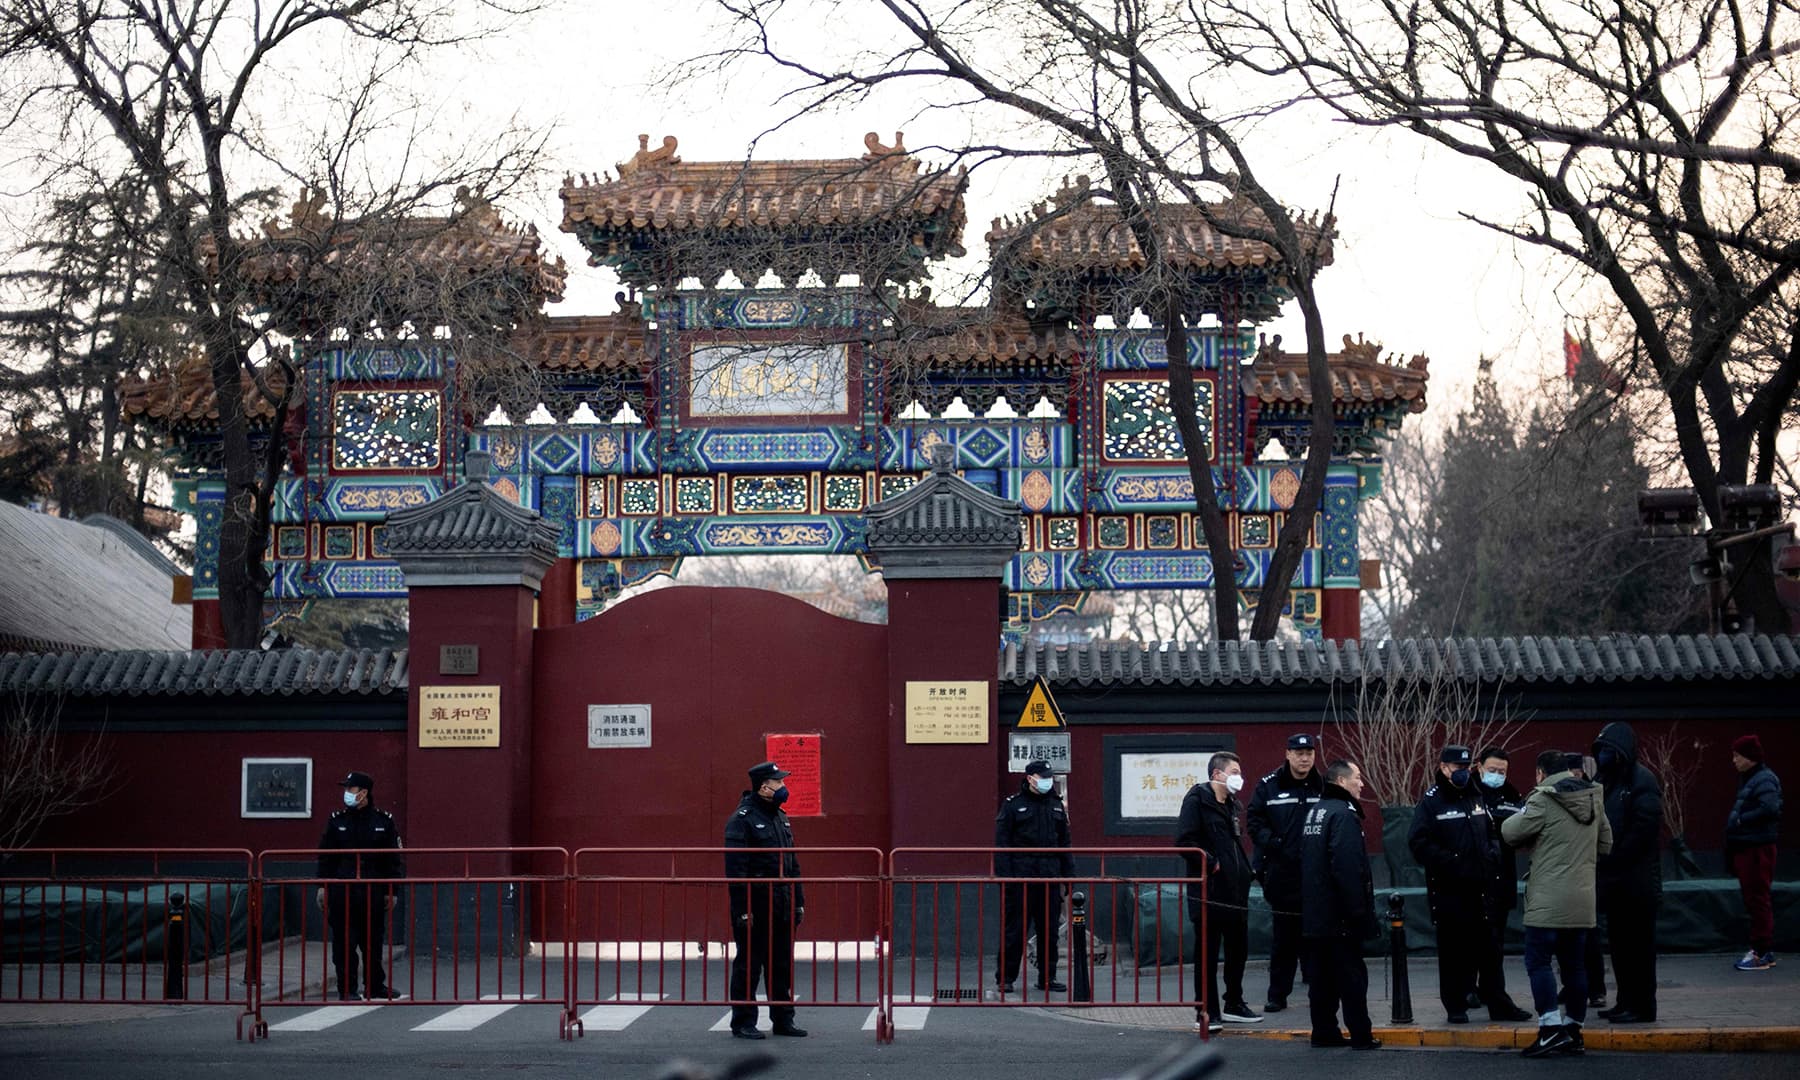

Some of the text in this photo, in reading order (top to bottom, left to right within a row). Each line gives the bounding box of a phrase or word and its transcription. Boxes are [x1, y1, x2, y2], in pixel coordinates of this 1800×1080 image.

[928, 687, 967, 696] 开放时间
[429, 706, 491, 721] 雍和宫
[1031, 703, 1046, 723] 慢
[602, 715, 636, 724] 消防通道
[594, 728, 645, 737] 门前禁放车辆
[1013, 745, 1067, 760] 请游人避让车辆
